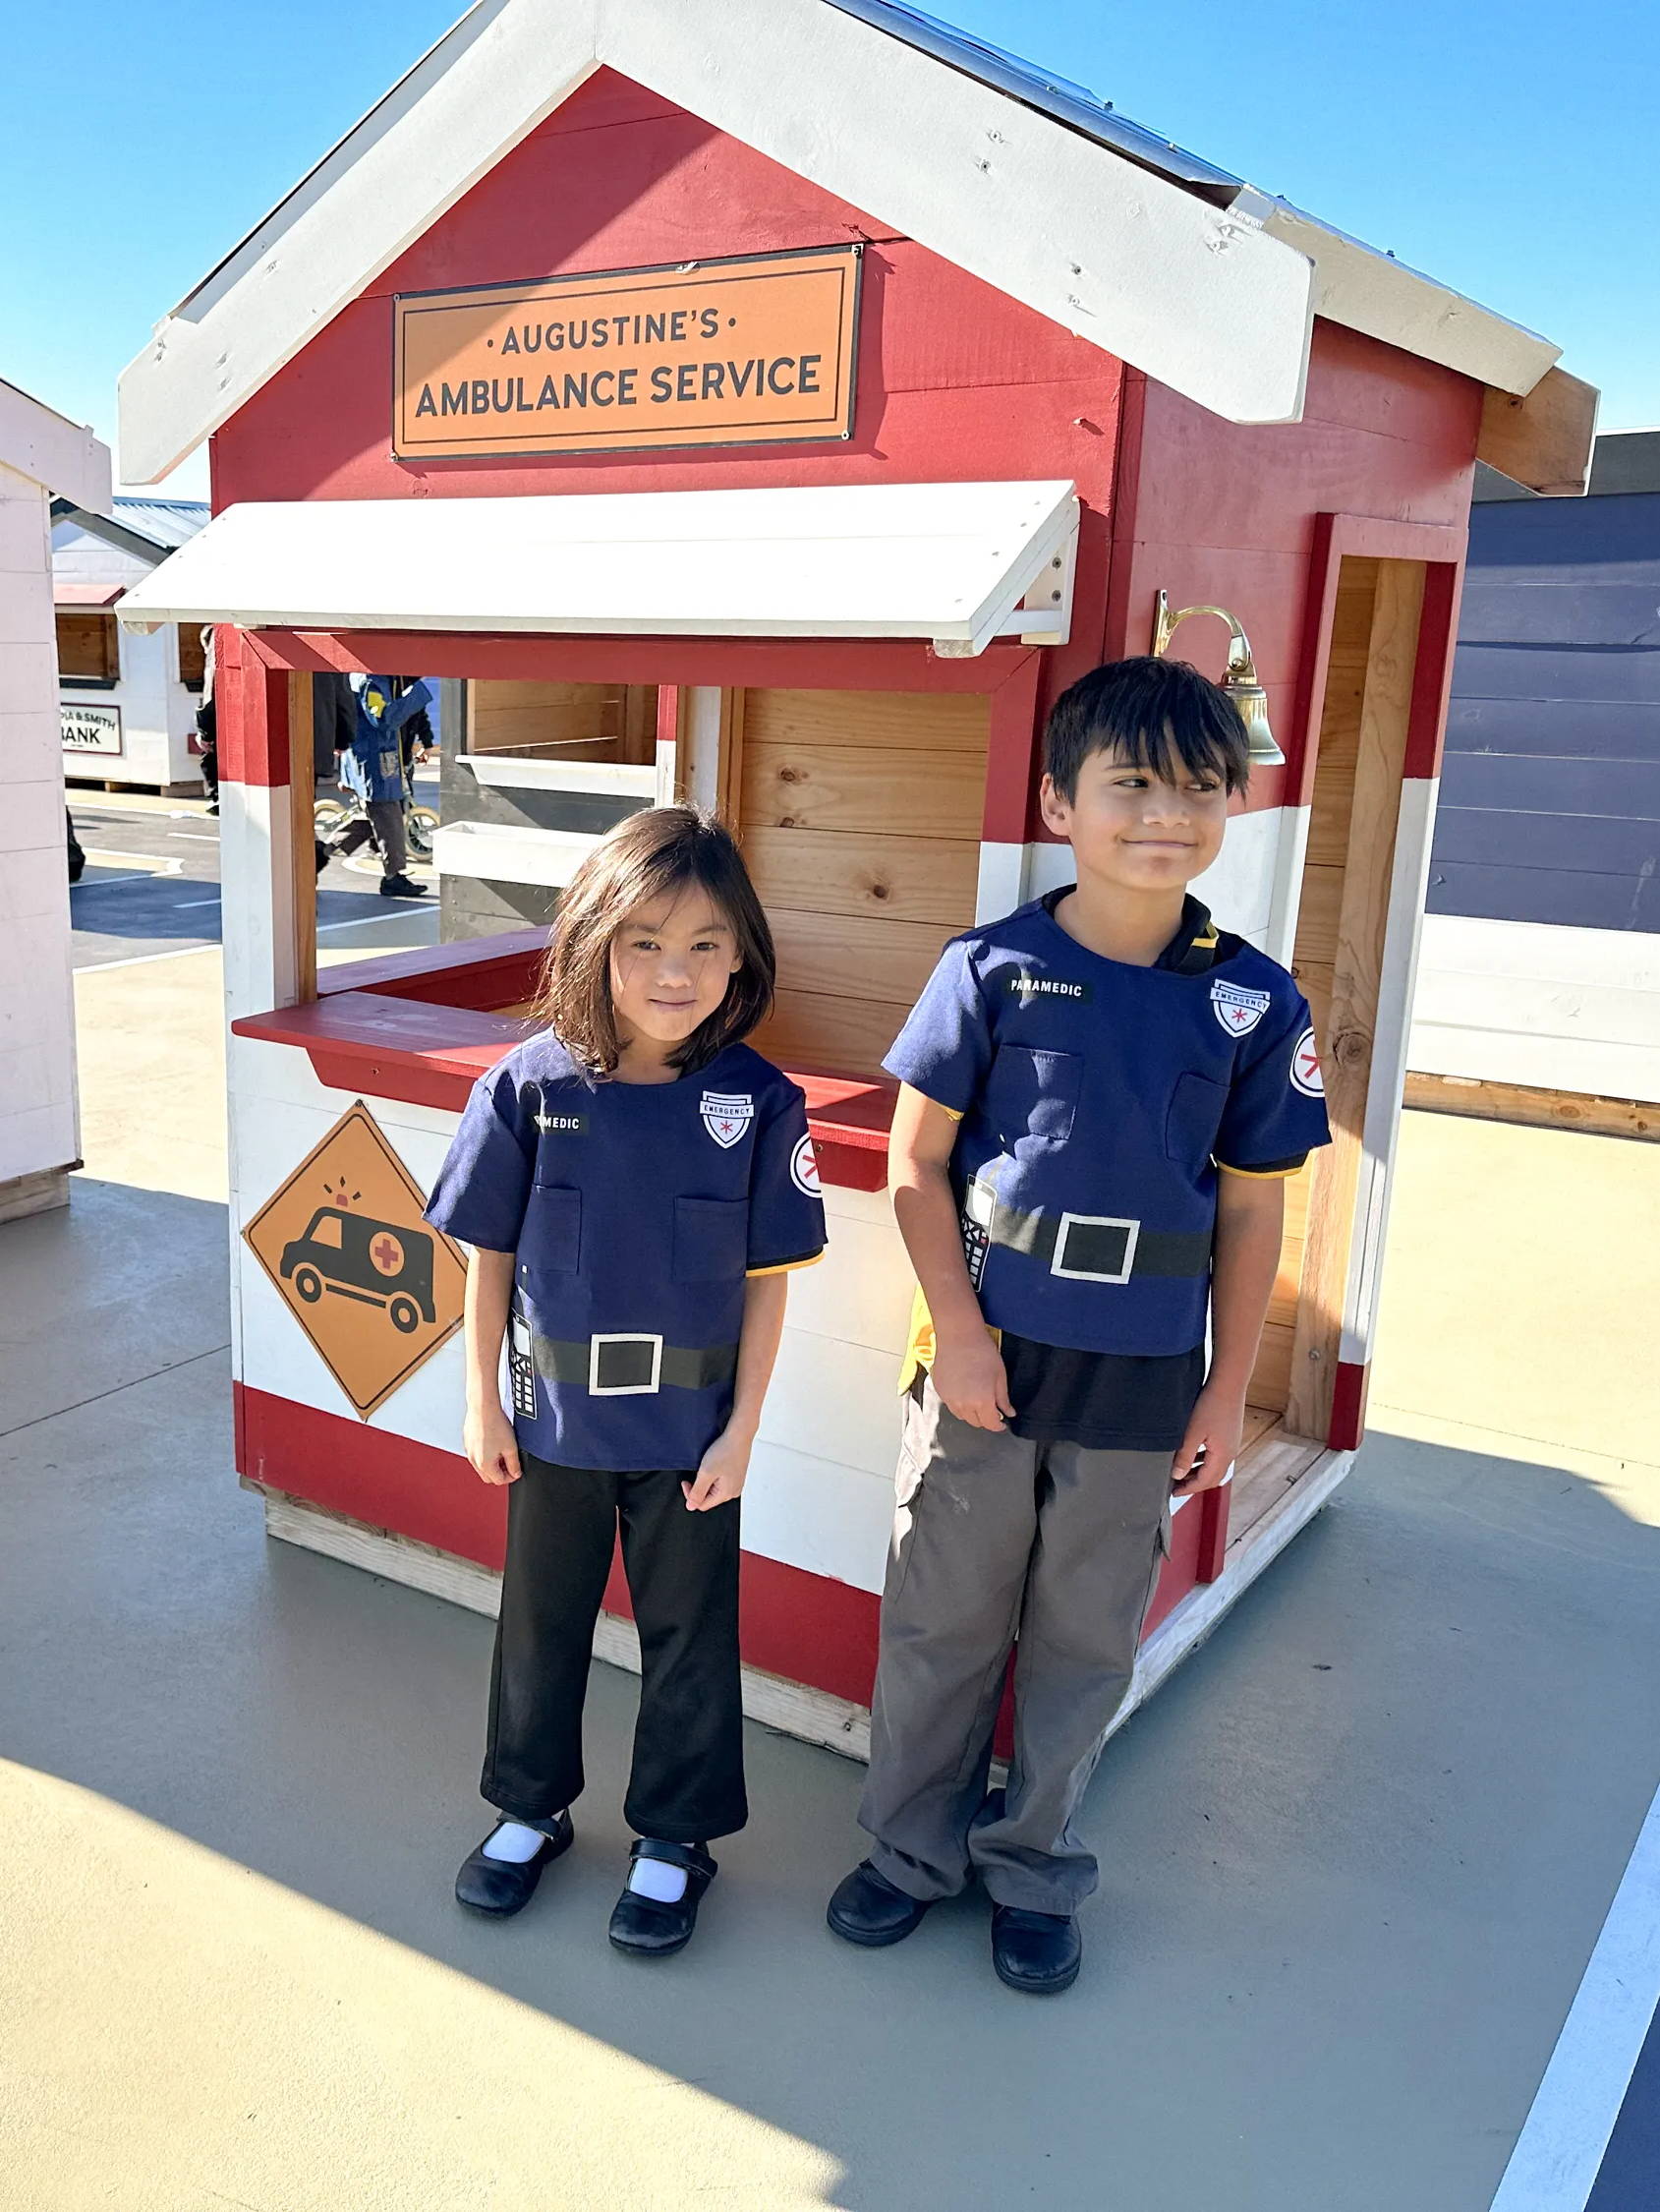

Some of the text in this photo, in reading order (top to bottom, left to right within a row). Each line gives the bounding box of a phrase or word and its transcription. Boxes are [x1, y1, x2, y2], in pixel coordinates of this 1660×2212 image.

[500, 308, 719, 355] AUGUSTINE'S
[415, 354, 822, 418] AMBULANCE SERVICE
[85, 713, 116, 730] SMITH
[1010, 979, 1082, 997] PARAMEDIC
[1215, 991, 1267, 1009] EMERGENCY
[704, 1104, 750, 1115] EMERGENCY
